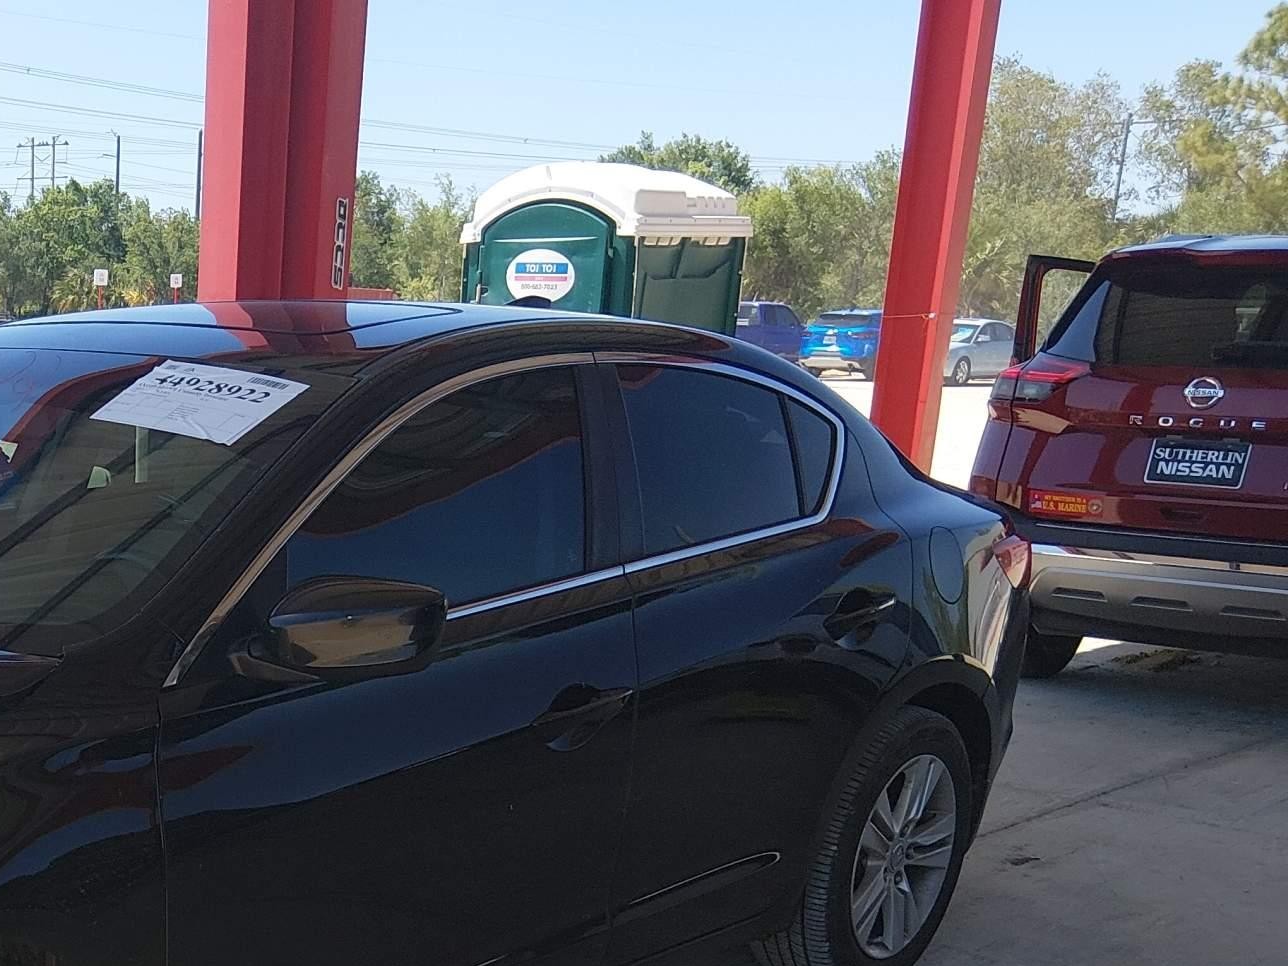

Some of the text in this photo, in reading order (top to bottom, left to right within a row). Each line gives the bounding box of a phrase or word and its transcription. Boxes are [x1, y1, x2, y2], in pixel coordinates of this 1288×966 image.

[525, 264, 558, 273] TOI TOI
[155, 374, 271, 404] 44928922
[1187, 389, 1220, 397] NISSAN
[1129, 415, 1266, 431] ROGUE
[1154, 447, 1247, 465] SUTHERLIN
[1156, 461, 1235, 479] NISSAN
[1043, 501, 1087, 513] U.S. MARINE
